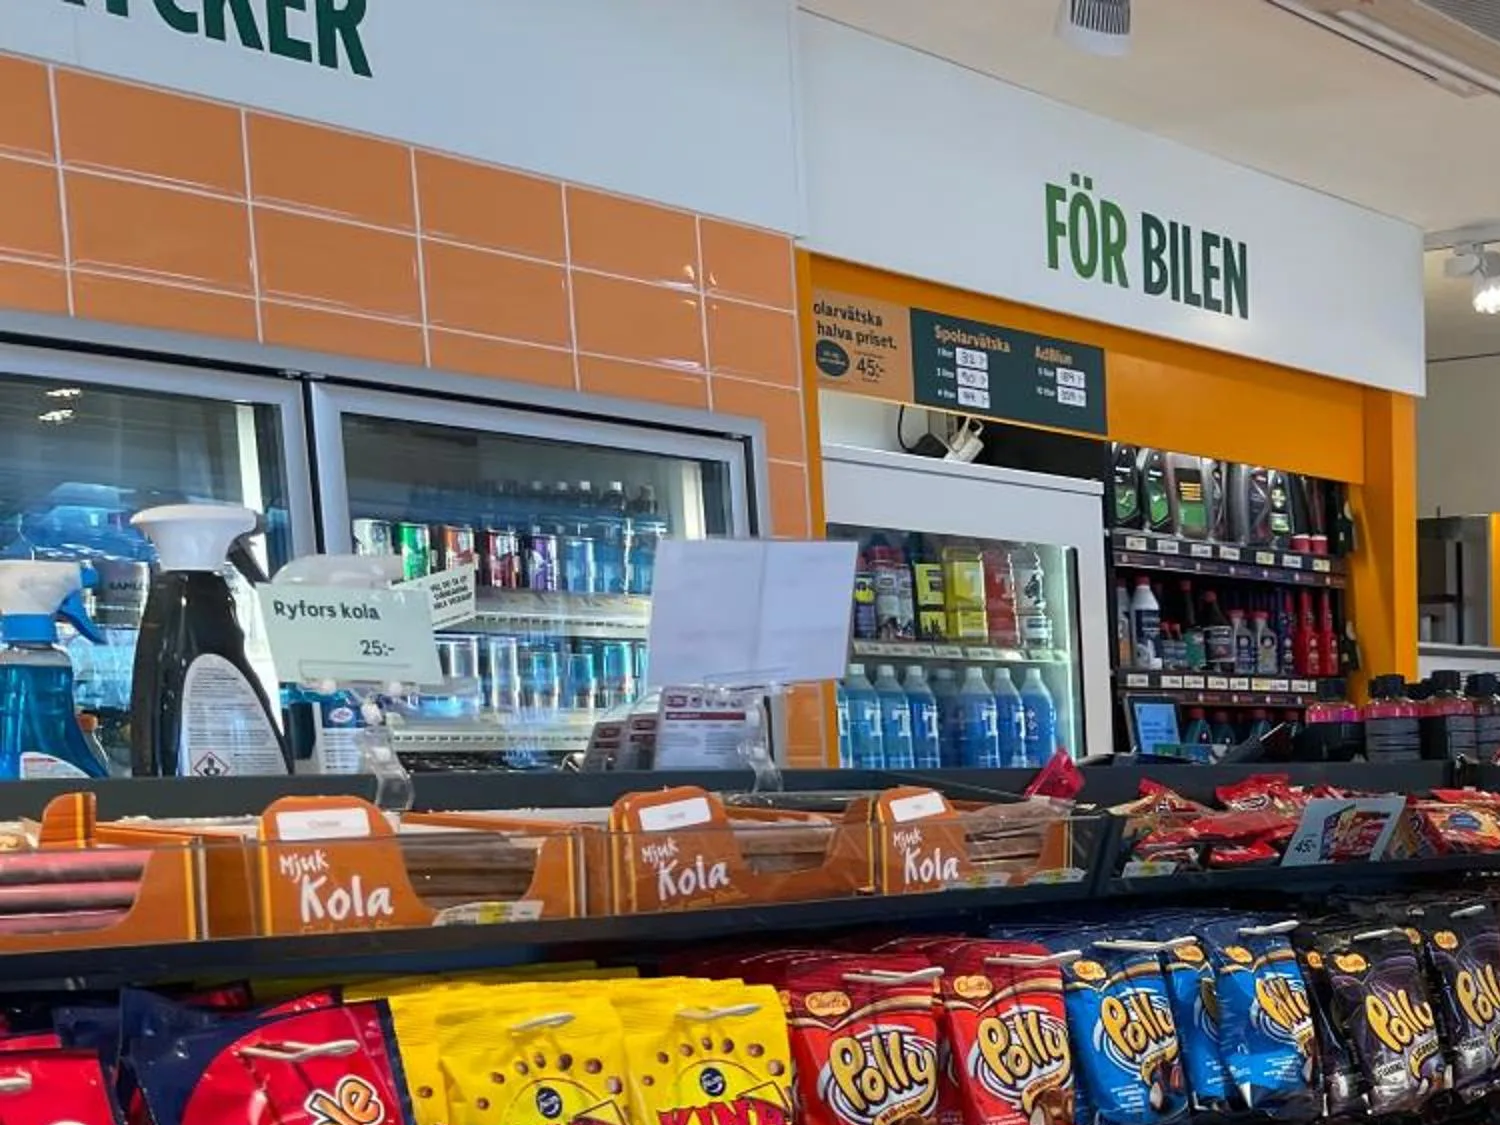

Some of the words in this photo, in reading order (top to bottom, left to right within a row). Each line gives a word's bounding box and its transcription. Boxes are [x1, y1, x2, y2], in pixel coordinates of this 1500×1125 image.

[1046, 173, 1129, 288] FÖR
[1141, 211, 1248, 320] BILEN
[816, 322, 853, 342] halva
[855, 329, 898, 350] priset.
[341, 602, 381, 621] kola
[640, 839, 680, 867] Mjuk
[892, 828, 923, 853] Mjuk
[279, 847, 329, 883] Mjuk
[657, 854, 730, 901] Kola
[903, 846, 960, 884] Kola
[299, 873, 394, 922] Kola
[1101, 993, 1176, 1058] Polly
[977, 1010, 1071, 1086] Polly
[829, 1029, 937, 1111] Polly
